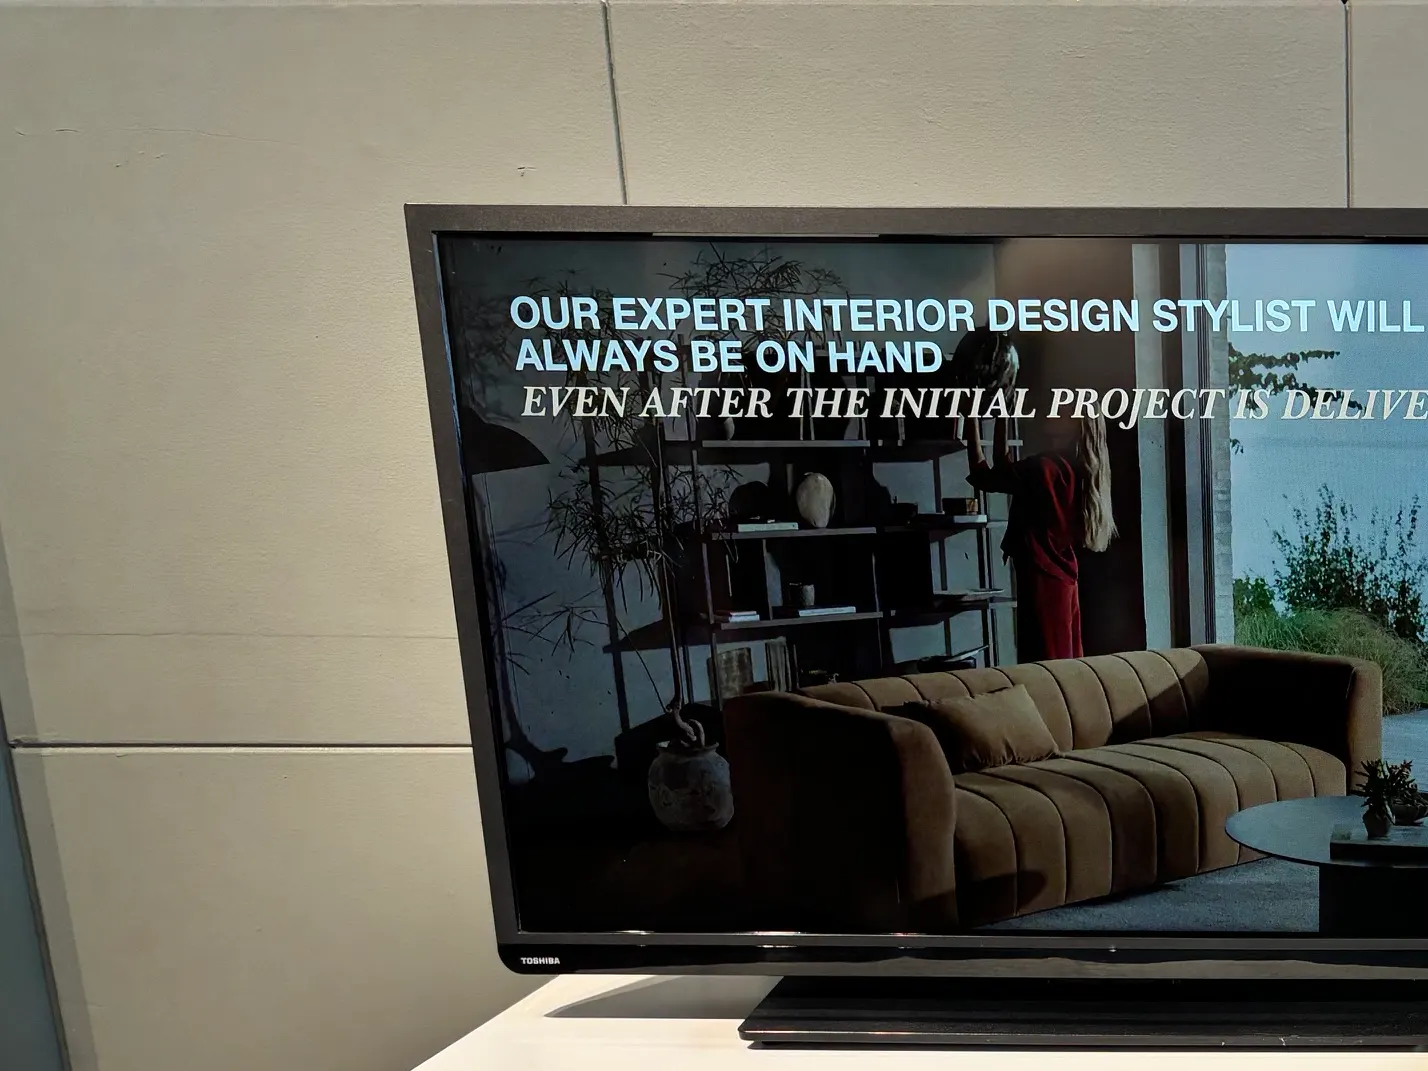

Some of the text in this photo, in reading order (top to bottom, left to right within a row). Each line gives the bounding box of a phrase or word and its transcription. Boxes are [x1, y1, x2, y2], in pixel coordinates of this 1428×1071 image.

[510, 296, 1426, 333] OUR EXPERT INTERIOR DESIGN STYLIST WILL
[515, 338, 943, 374] ALWAYS BE ON HAND
[520, 386, 629, 419] EVEN
[636, 386, 774, 420] AFTER
[783, 386, 870, 420] THE
[878, 386, 1037, 420] INITIAL
[1046, 388, 1226, 430] PROJECT
[1236, 389, 1270, 422] IS
[520, 957, 561, 965] TOSHIBA
